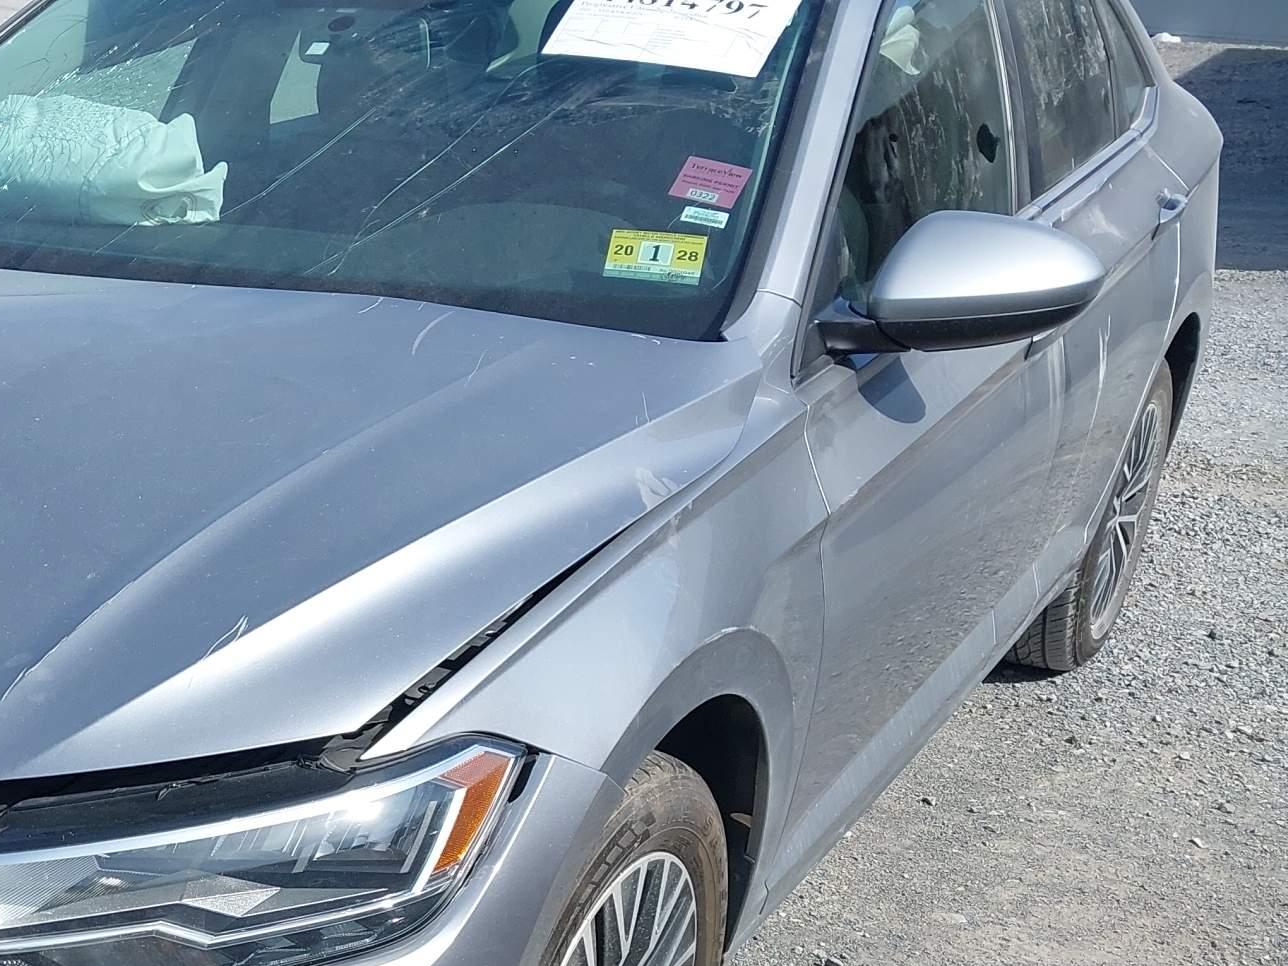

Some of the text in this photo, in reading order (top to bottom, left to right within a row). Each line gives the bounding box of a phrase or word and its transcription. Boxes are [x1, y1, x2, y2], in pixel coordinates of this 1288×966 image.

[690, 190, 716, 201] 0322
[613, 244, 699, 262] 20 1 28
